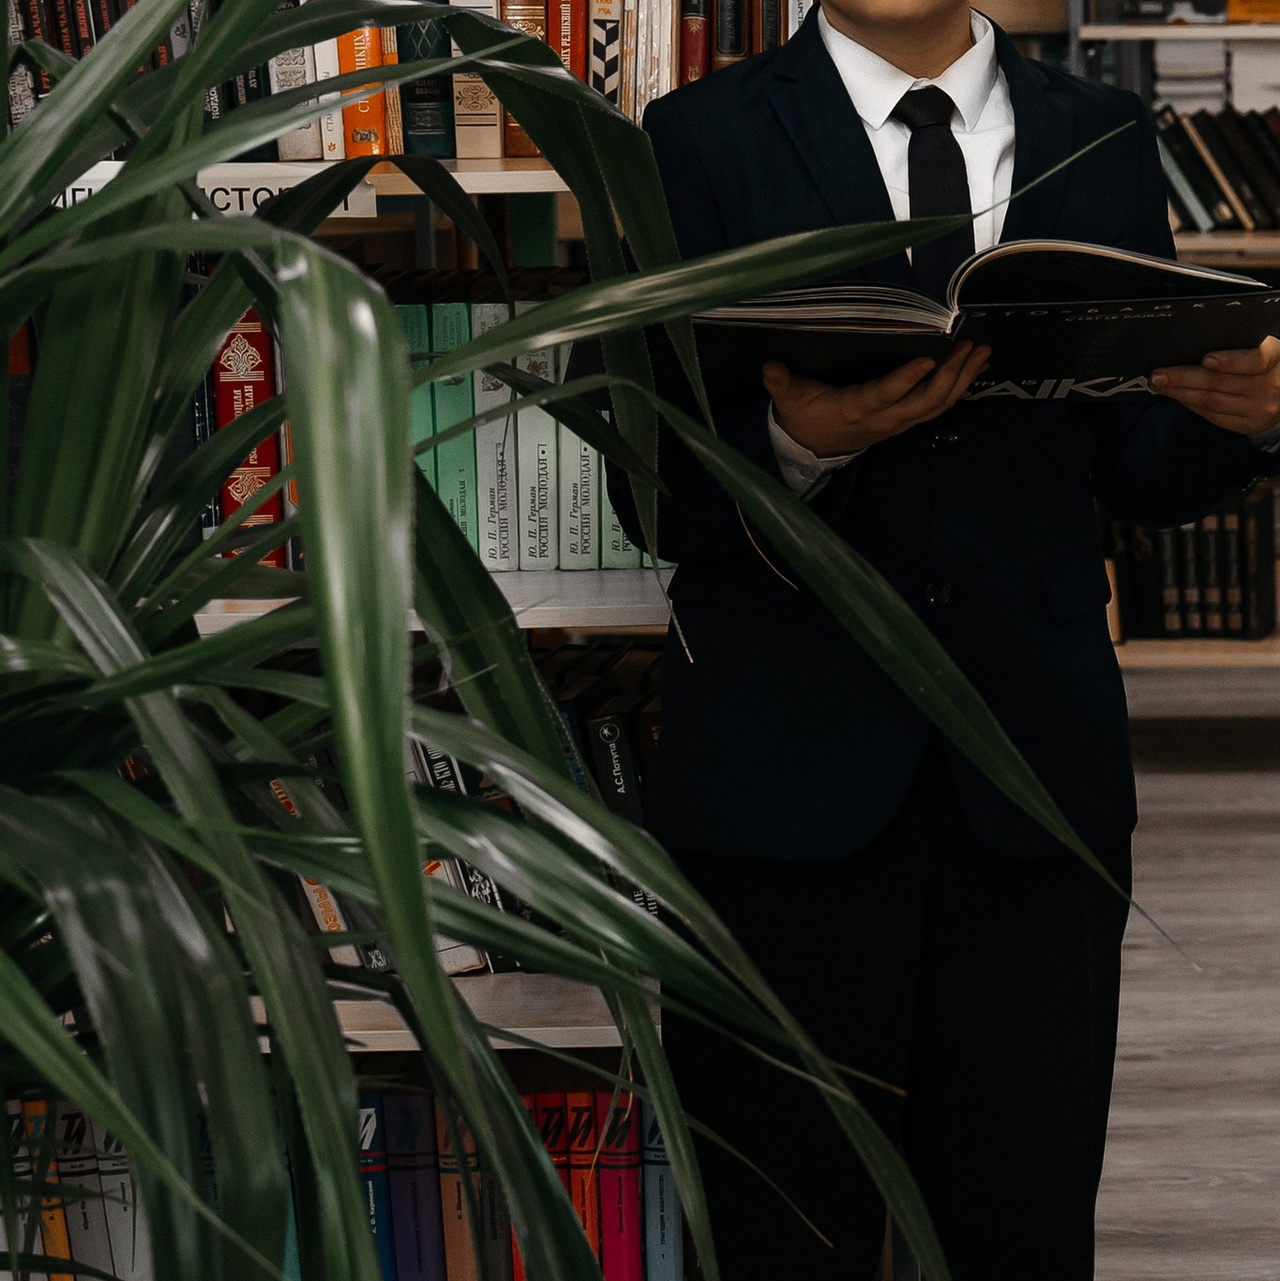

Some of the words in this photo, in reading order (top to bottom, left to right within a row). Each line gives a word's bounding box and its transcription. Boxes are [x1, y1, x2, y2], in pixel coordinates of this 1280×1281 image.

[559, 3, 572, 46] РЕЛИКВИЙ
[962, 375, 1156, 401] AIKA
[498, 456, 508, 512] МОЛОДАЯ
[538, 457, 548, 512] МОЛОДАЯ
[569, 482, 581, 521] Герман
[580, 454, 590, 509] МОЛОДАЯ
[487, 487, 500, 525] Герман
[527, 485, 539, 524] Герман
[500, 516, 510, 560] РОССИЯ
[539, 514, 549, 559] РОССИЯ
[580, 512, 591, 555] РОССИЯ
